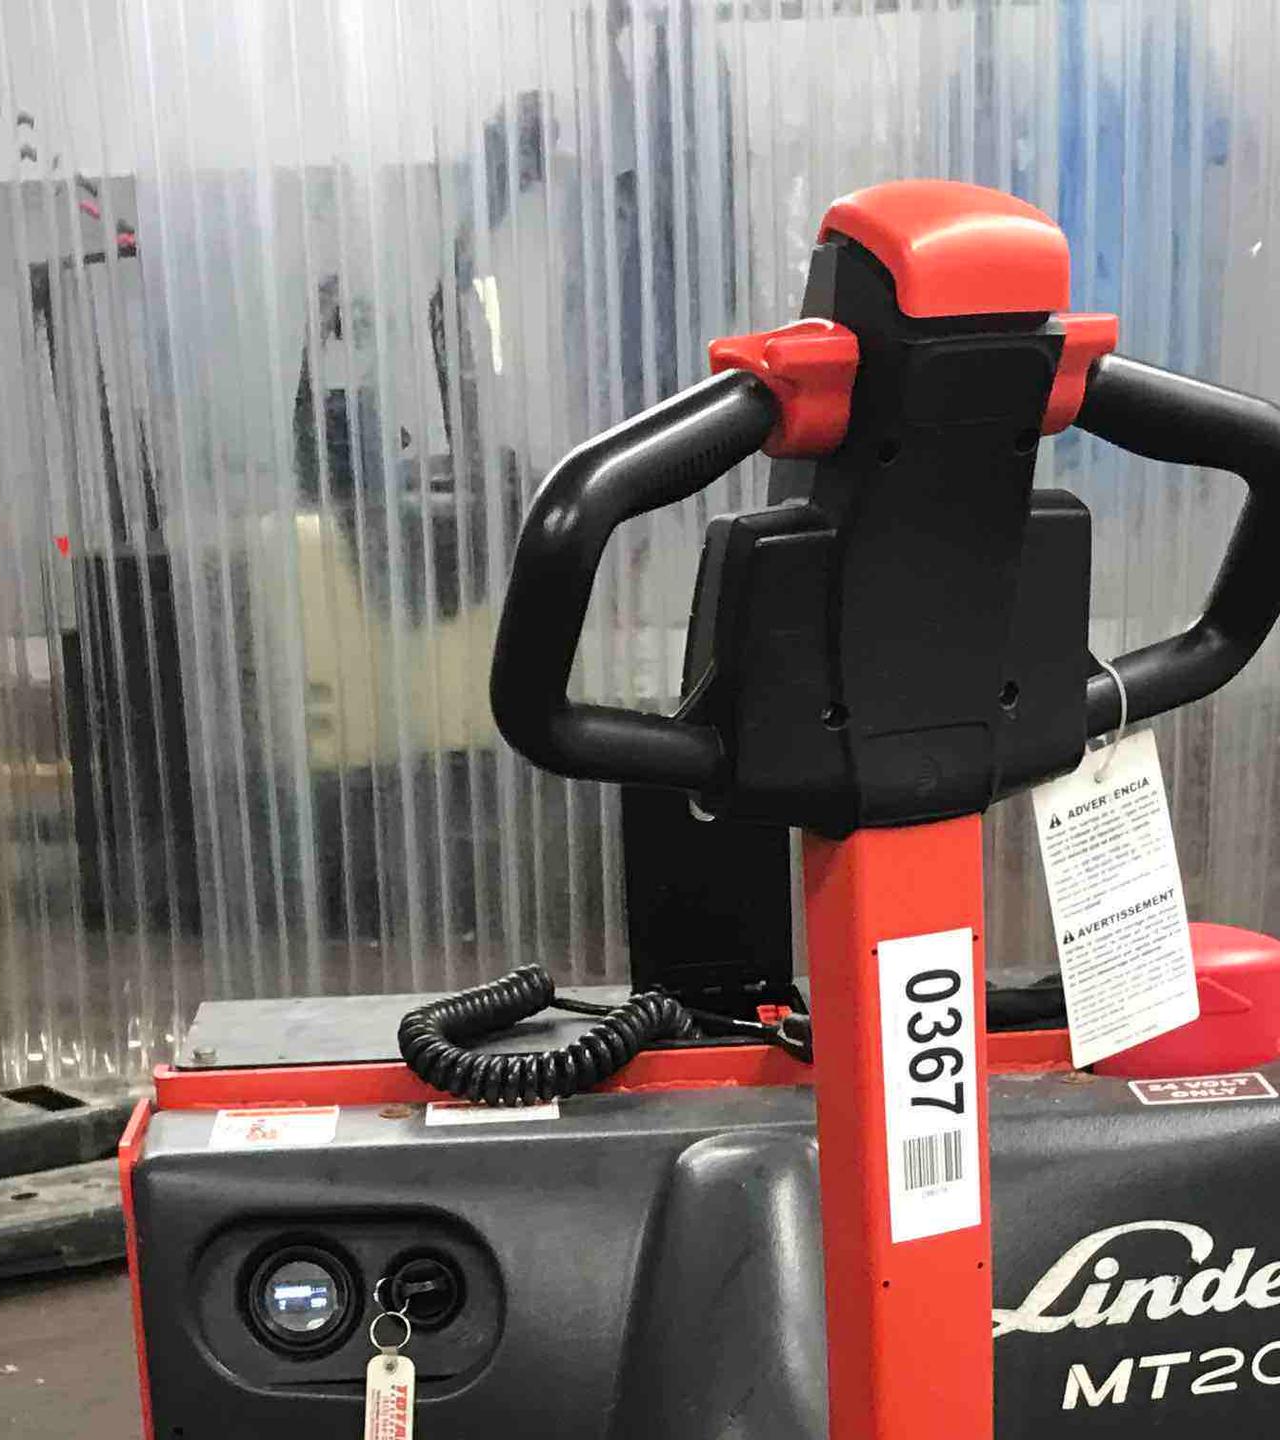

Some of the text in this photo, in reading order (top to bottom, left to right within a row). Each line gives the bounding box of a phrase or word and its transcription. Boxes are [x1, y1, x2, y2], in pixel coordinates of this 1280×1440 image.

[1067, 776, 1151, 819] ADVERENCIA
[1077, 887, 1175, 939] AVERTISSEMENT
[905, 968, 965, 1115] 0367
[1170, 1087, 1238, 1098] ONLY
[1184, 1078, 1250, 1089] VOLT
